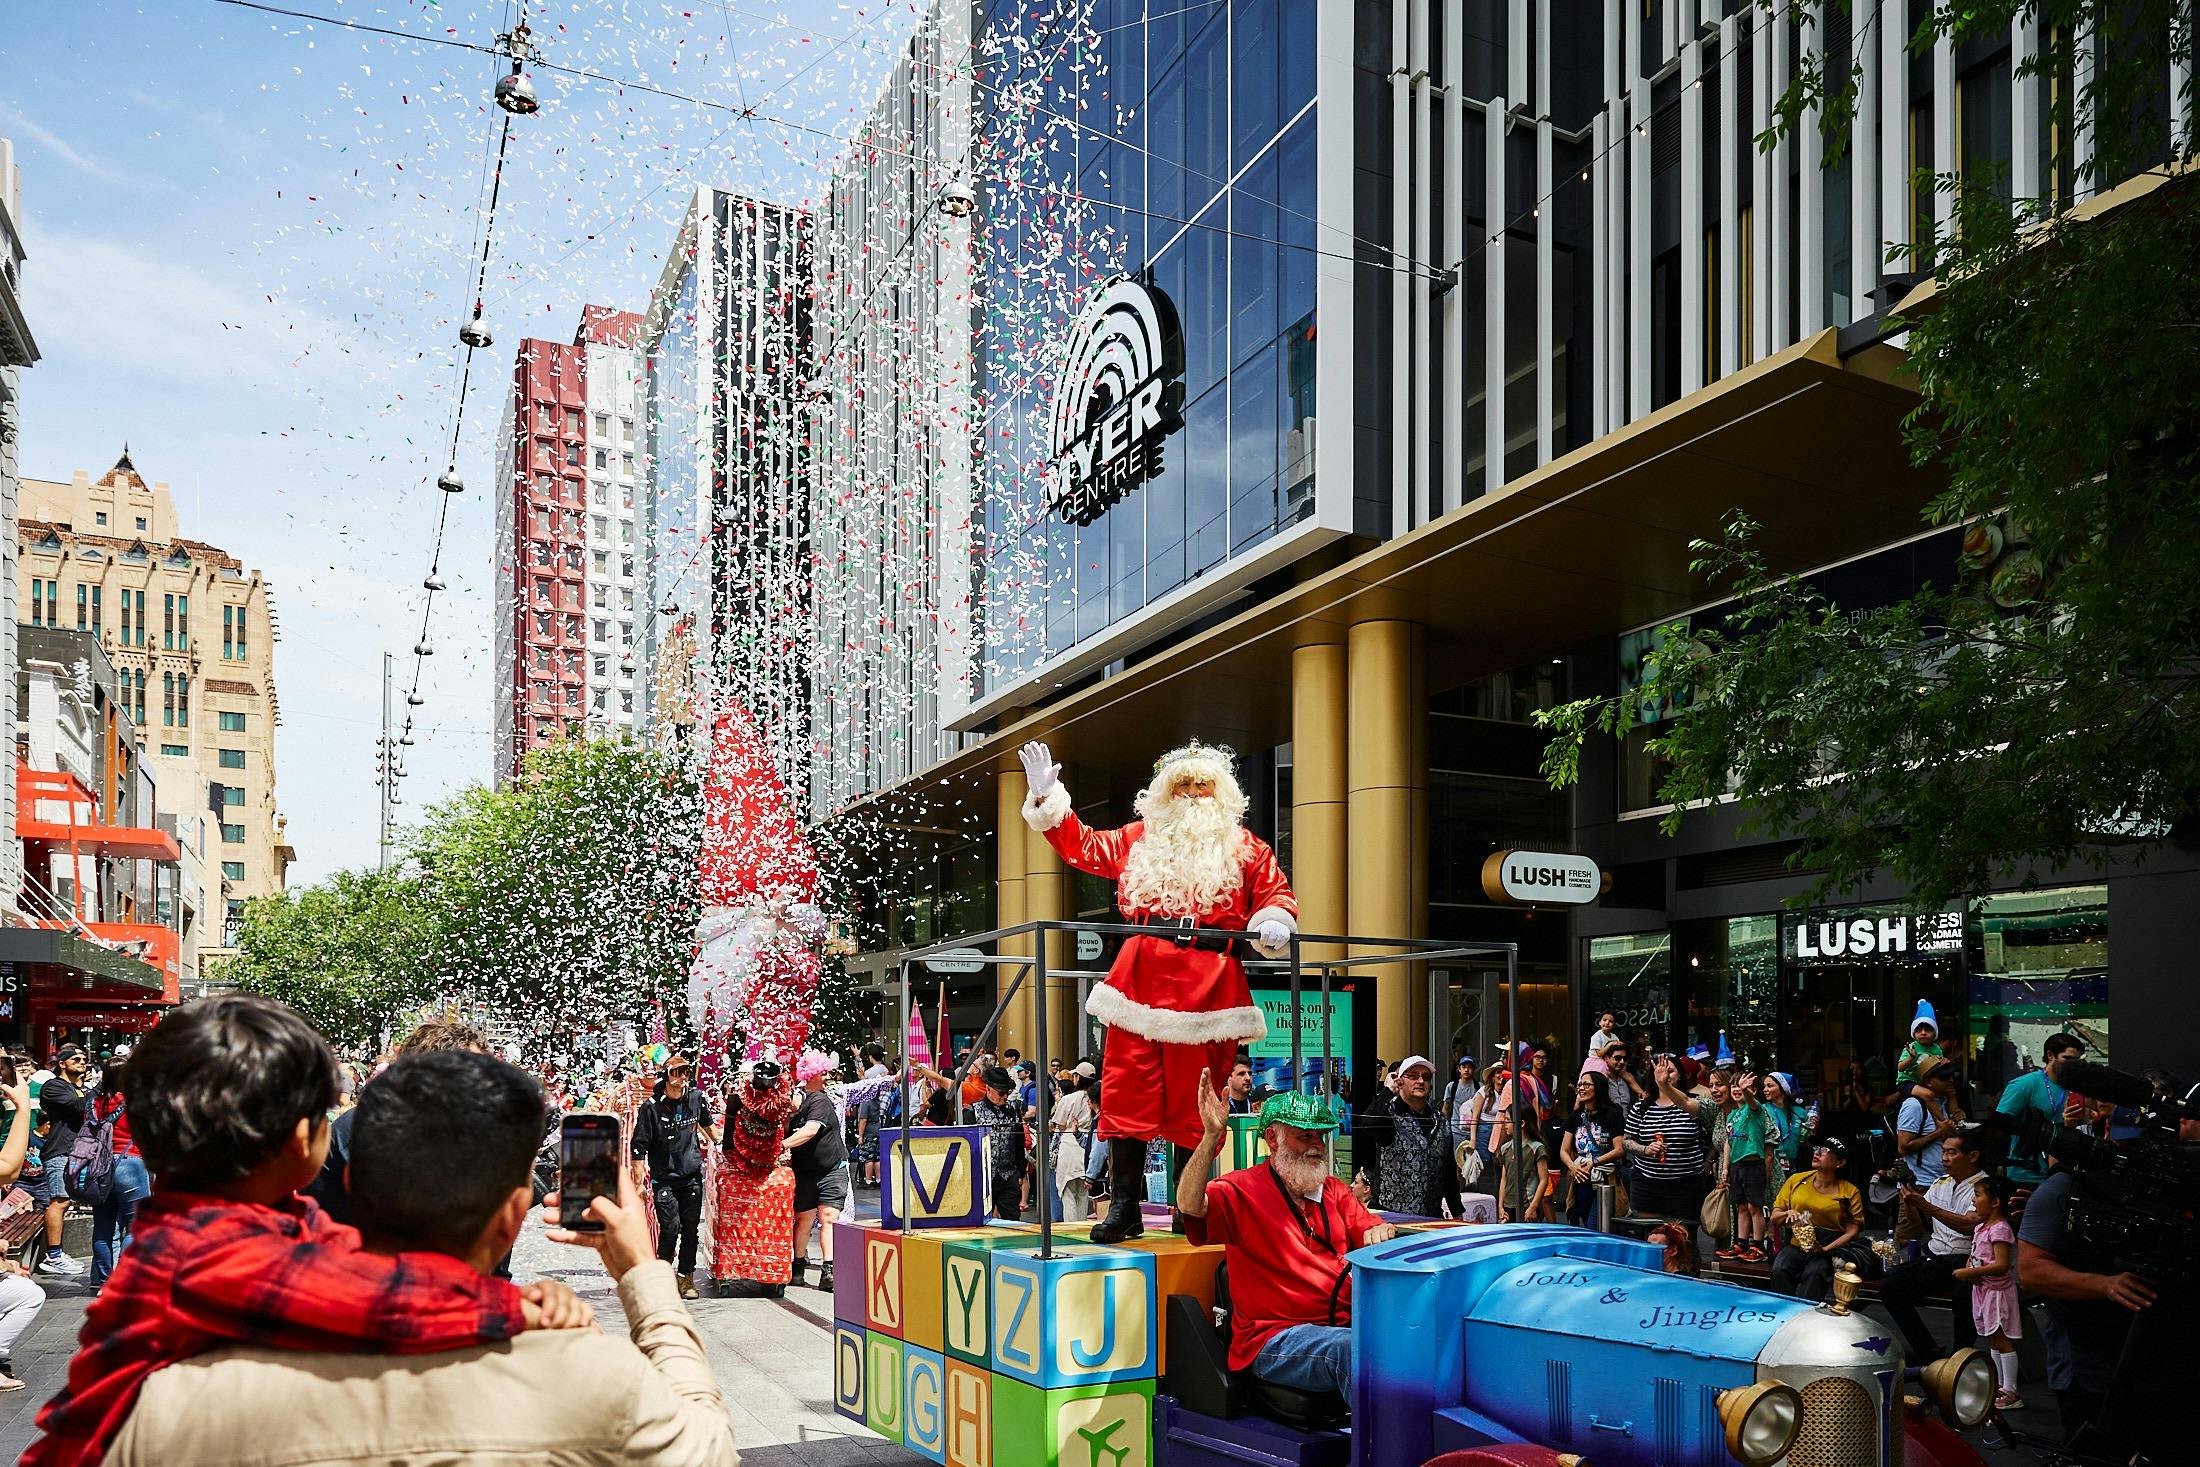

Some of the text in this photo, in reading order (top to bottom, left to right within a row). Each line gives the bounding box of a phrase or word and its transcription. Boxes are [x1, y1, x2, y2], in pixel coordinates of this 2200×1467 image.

[1045, 378, 1163, 505] MYER
[1060, 443, 1143, 523] CENTRE
[1511, 866, 1565, 887] LUSH
[1568, 869, 1592, 878] FRESH
[1797, 917, 1907, 957] LUSH
[1307, 1006, 1321, 1014] on
[897, 1141, 962, 1215] V
[872, 1245, 1033, 1367] K Y Z
[1515, 1271, 1600, 1288] Jolly
[1599, 1287, 1630, 1305] &
[1069, 1275, 1116, 1368] J
[840, 1333, 981, 1457] D U G H
